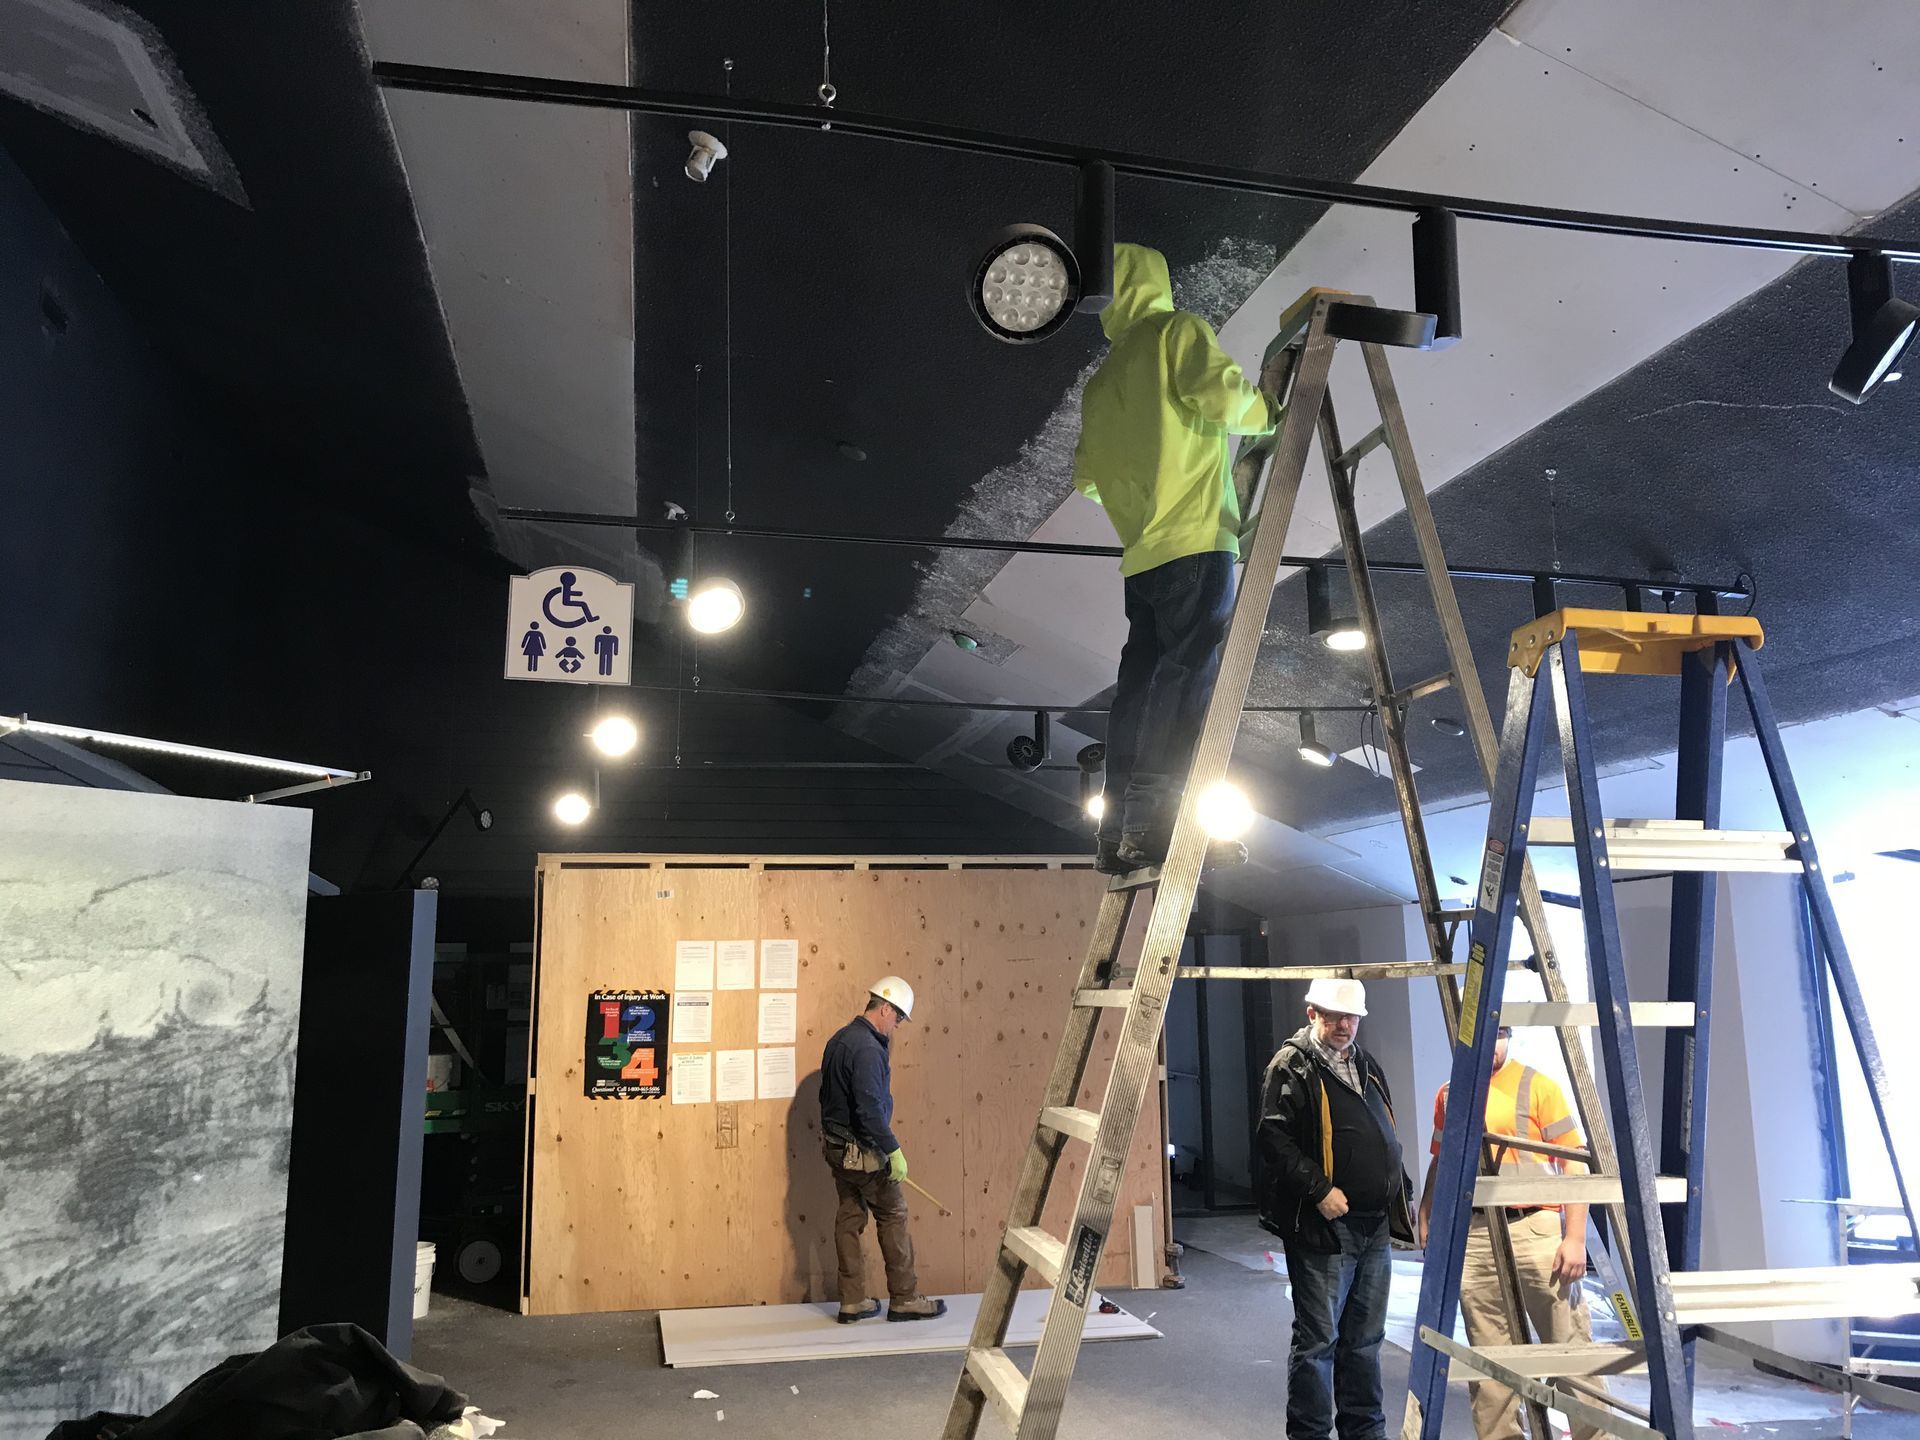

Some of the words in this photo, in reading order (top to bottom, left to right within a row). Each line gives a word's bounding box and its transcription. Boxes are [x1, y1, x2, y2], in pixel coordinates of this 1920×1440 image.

[600, 1001, 620, 1038] 1
[621, 1005, 655, 1044] 2
[598, 1033, 631, 1069] 3
[621, 1047, 659, 1086] 4
[1071, 1233, 1094, 1292] Louisville
[1614, 1293, 1641, 1338] FEATHERLITE
